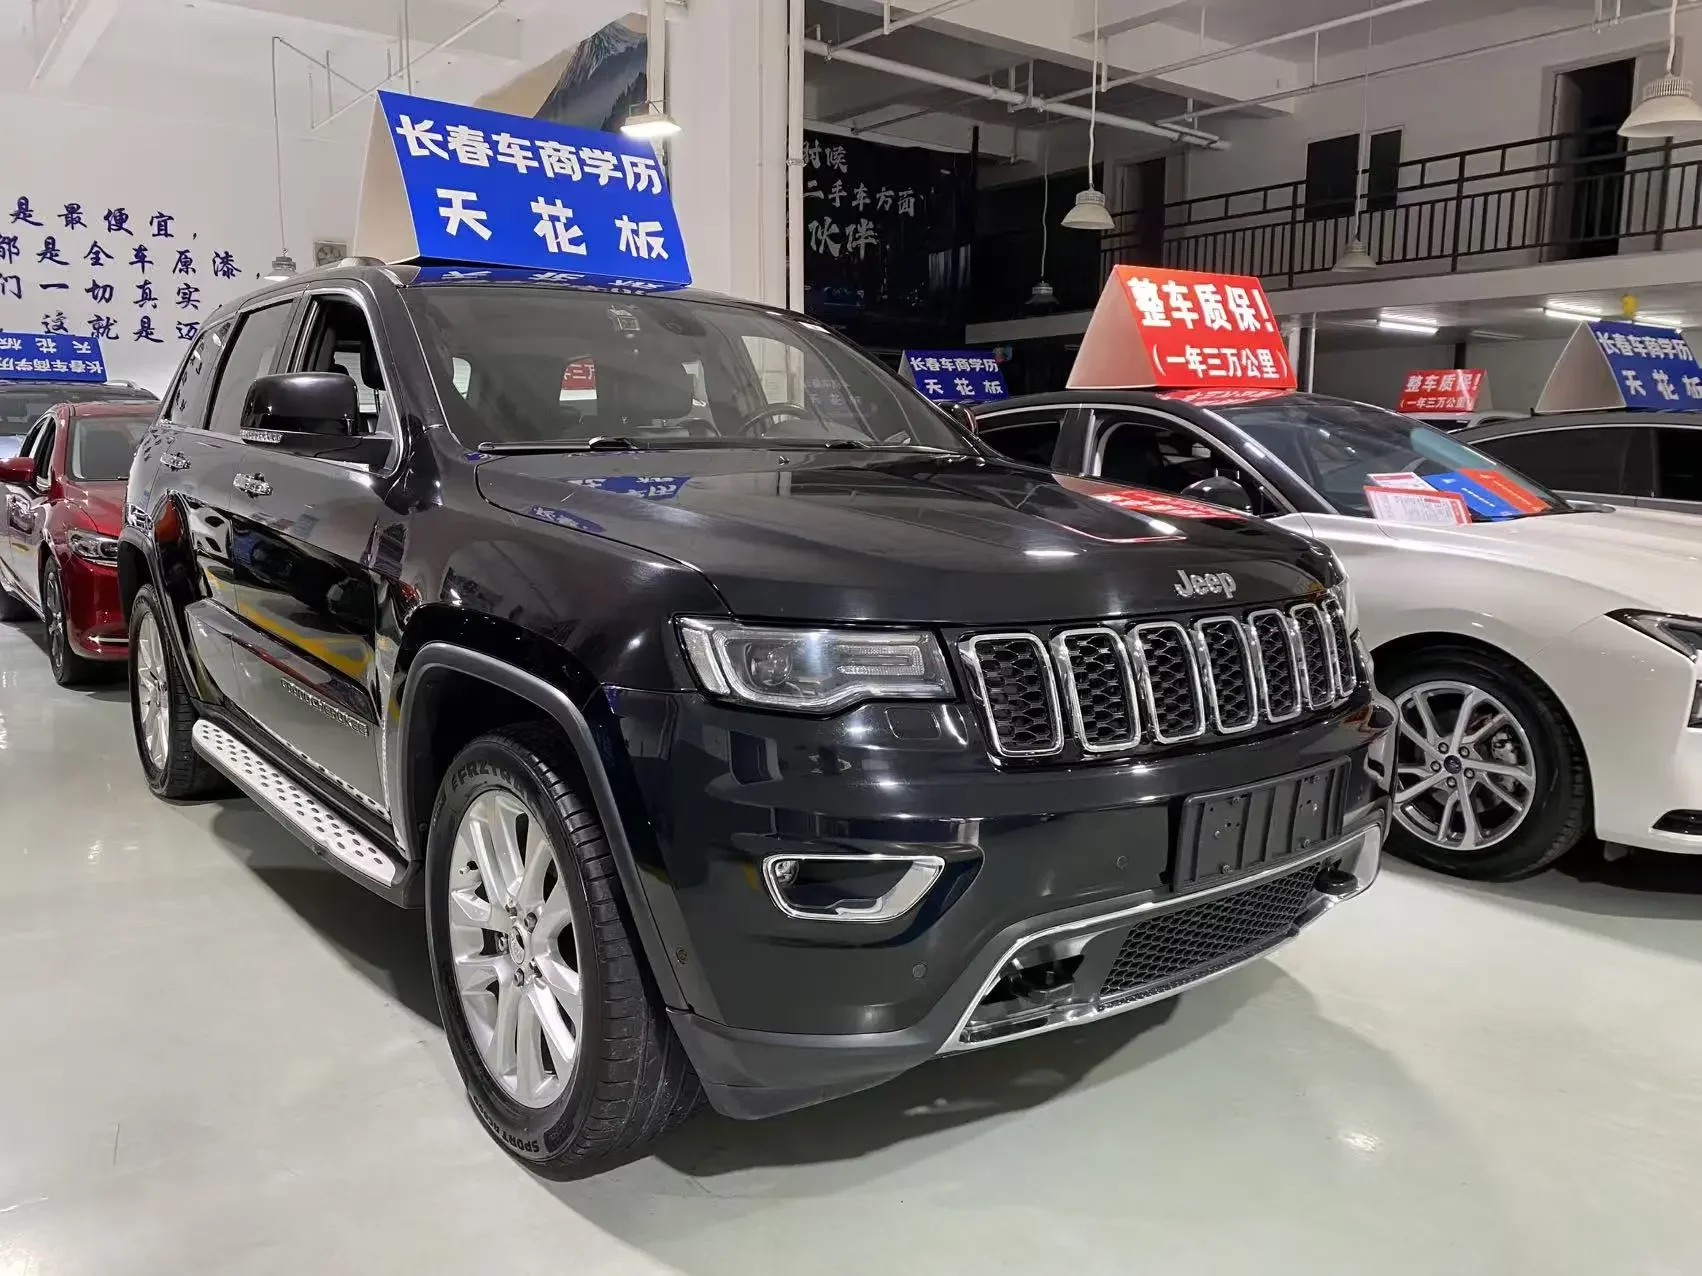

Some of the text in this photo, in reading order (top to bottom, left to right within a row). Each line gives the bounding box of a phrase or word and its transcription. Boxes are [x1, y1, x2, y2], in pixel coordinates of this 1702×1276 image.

[395, 114, 663, 195] 长春车商学历
[436, 187, 670, 260] 天花板
[1596, 331, 1693, 361] 长春车商学历
[910, 357, 999, 373] 长春车商学历
[924, 377, 1004, 396] 天花板
[1174, 569, 1237, 599] Jeep
